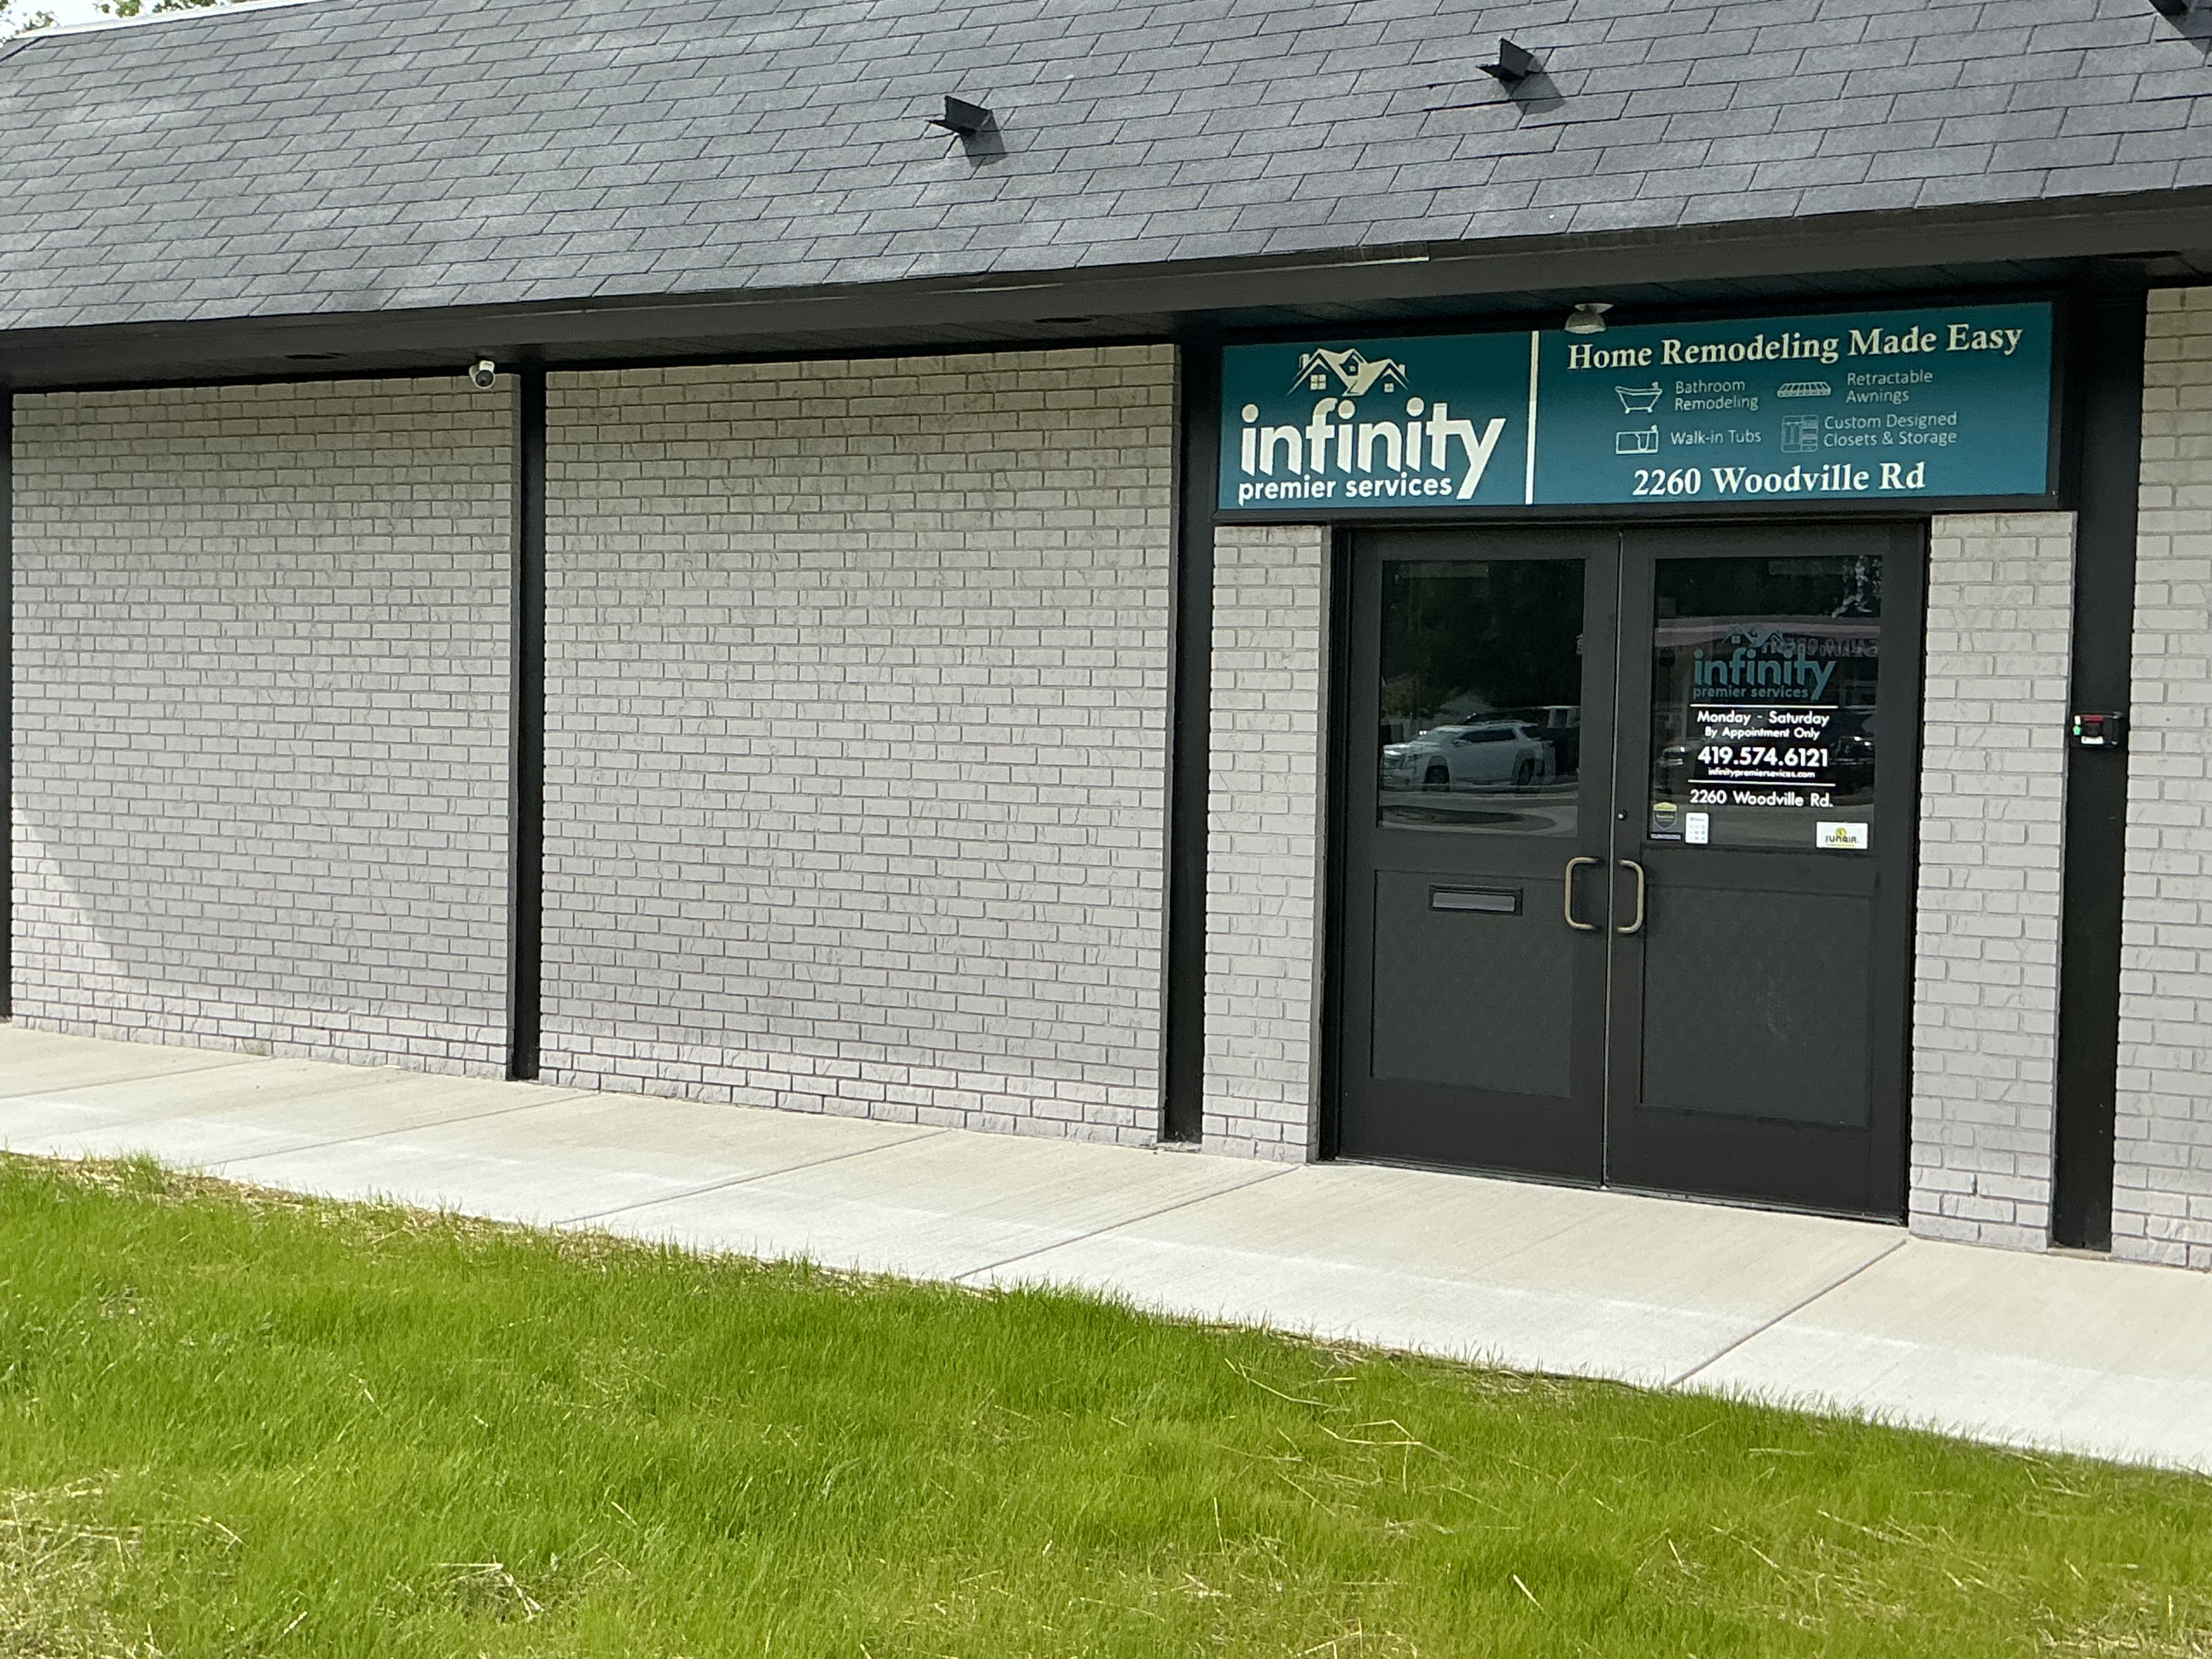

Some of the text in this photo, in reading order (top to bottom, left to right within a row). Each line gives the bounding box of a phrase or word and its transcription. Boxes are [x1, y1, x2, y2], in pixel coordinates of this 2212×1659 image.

[1567, 323, 2023, 370] Home Remodeling Made Easy
[1675, 380, 1746, 394] Bathroom
[1847, 369, 1933, 386] Retractable
[1674, 395, 1759, 411] Remodeling
[1846, 388, 1910, 405] Awnings
[1824, 411, 1957, 430] Custom Designed
[1670, 428, 1762, 445] Walk-in Tubs
[1823, 430, 1957, 448] Closets & Storage
[1240, 396, 1506, 500] infinity
[1632, 461, 1927, 496] 2260 Woodville Rd
[1239, 471, 1452, 507] premier services
[1694, 647, 1837, 701] infinity
[1693, 685, 1809, 699] premier services
[1697, 709, 1751, 726] Monday
[1768, 710, 1830, 728] Saturday
[1705, 726, 1821, 741] By Appointment Only
[1697, 746, 1829, 768] 419.574.6121
[1690, 788, 1834, 808] 2260 Woodville Rd.
